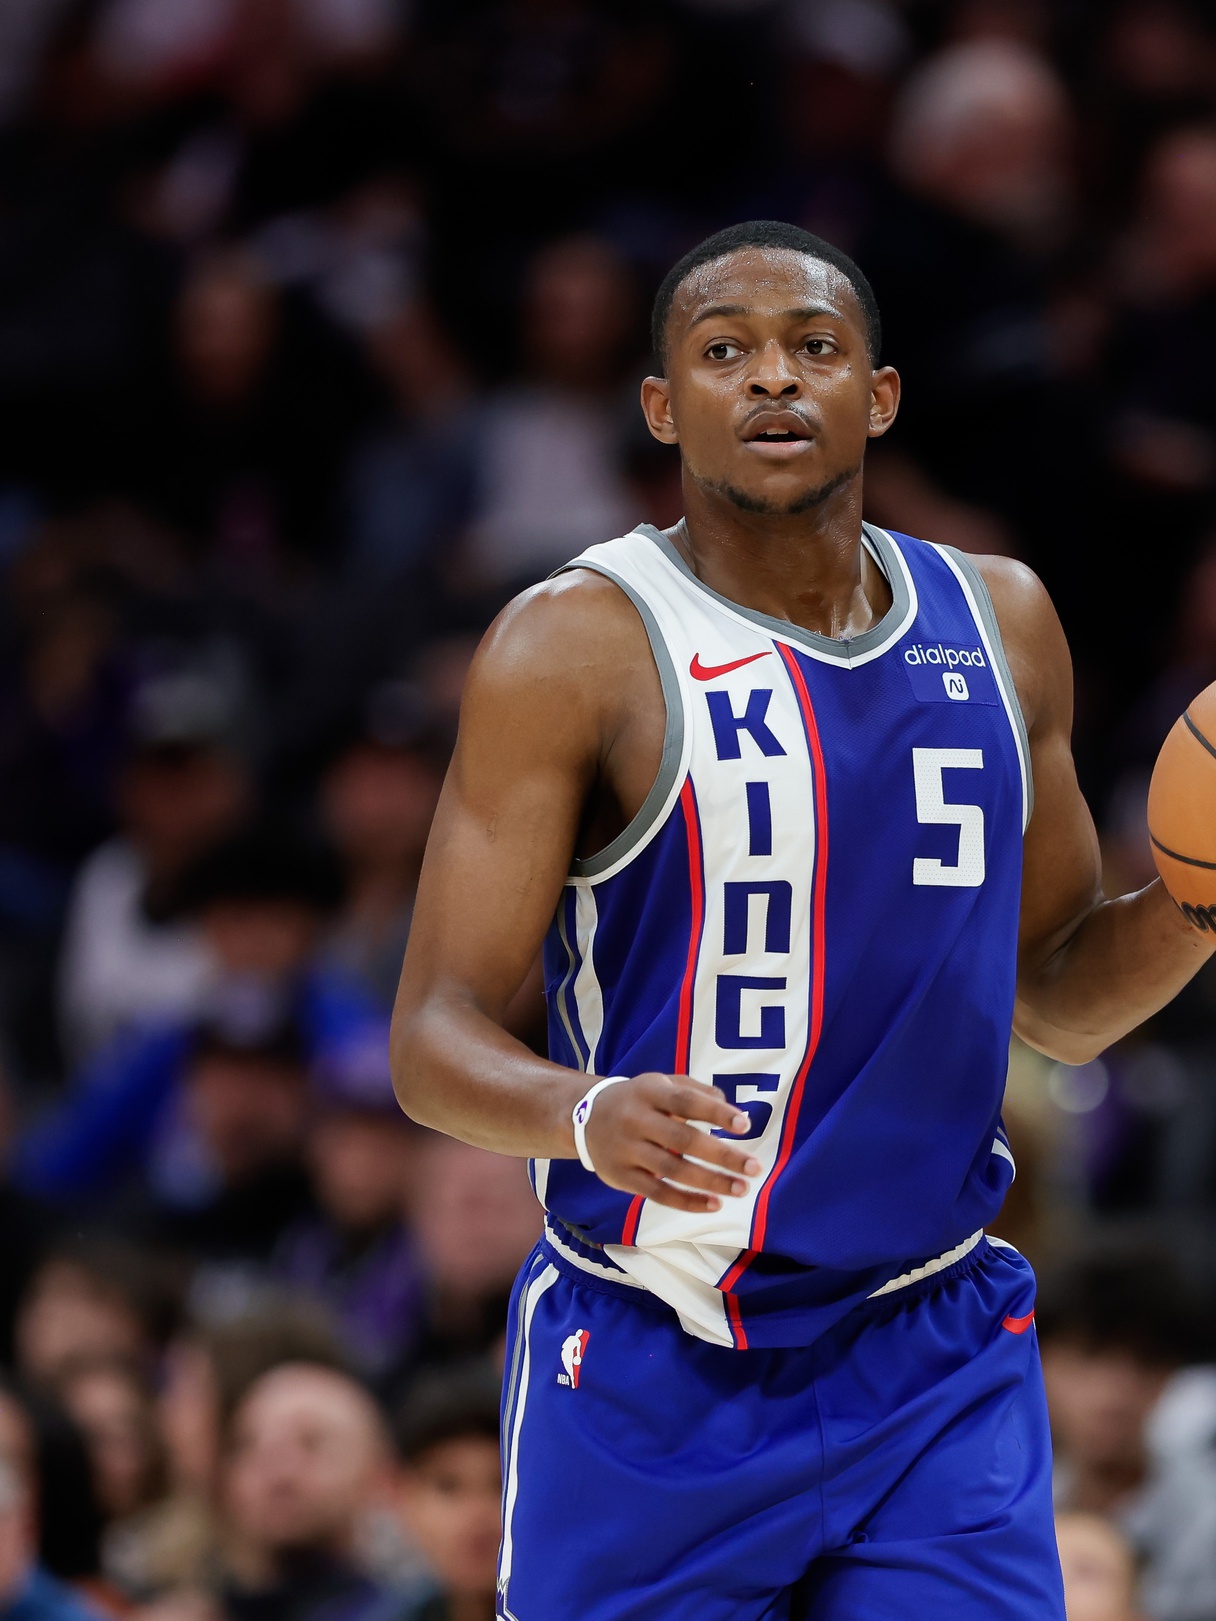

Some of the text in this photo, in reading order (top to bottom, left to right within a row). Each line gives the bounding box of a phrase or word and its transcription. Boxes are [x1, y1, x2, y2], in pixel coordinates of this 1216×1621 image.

[904, 643, 986, 669] dialpad
[912, 747, 986, 887] 5
[705, 689, 793, 1140] KINGS
[556, 1373, 570, 1386] NBA
